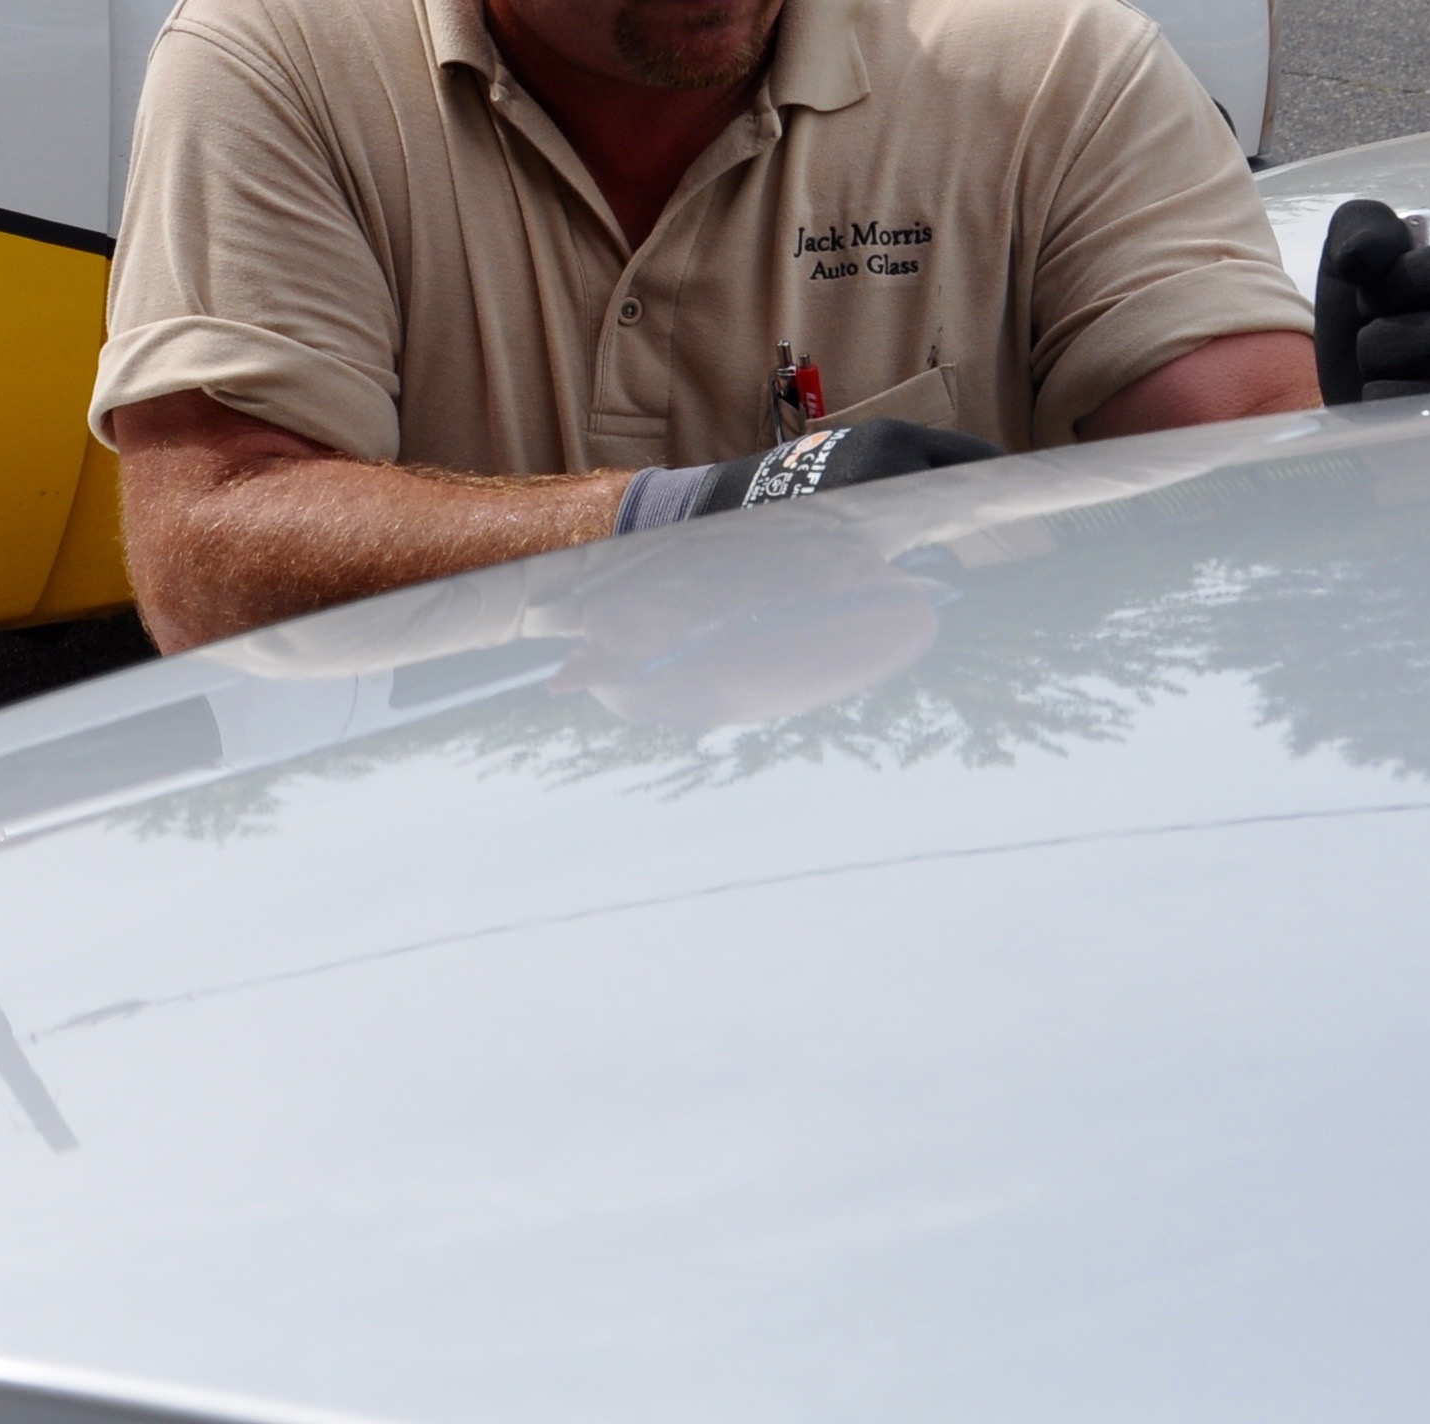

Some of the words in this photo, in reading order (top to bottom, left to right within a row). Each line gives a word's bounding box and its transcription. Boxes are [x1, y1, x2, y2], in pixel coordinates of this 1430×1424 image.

[793, 226, 844, 258] Jack
[850, 221, 932, 247] Morris
[810, 260, 859, 280] Auto
[867, 254, 919, 275] Glass
